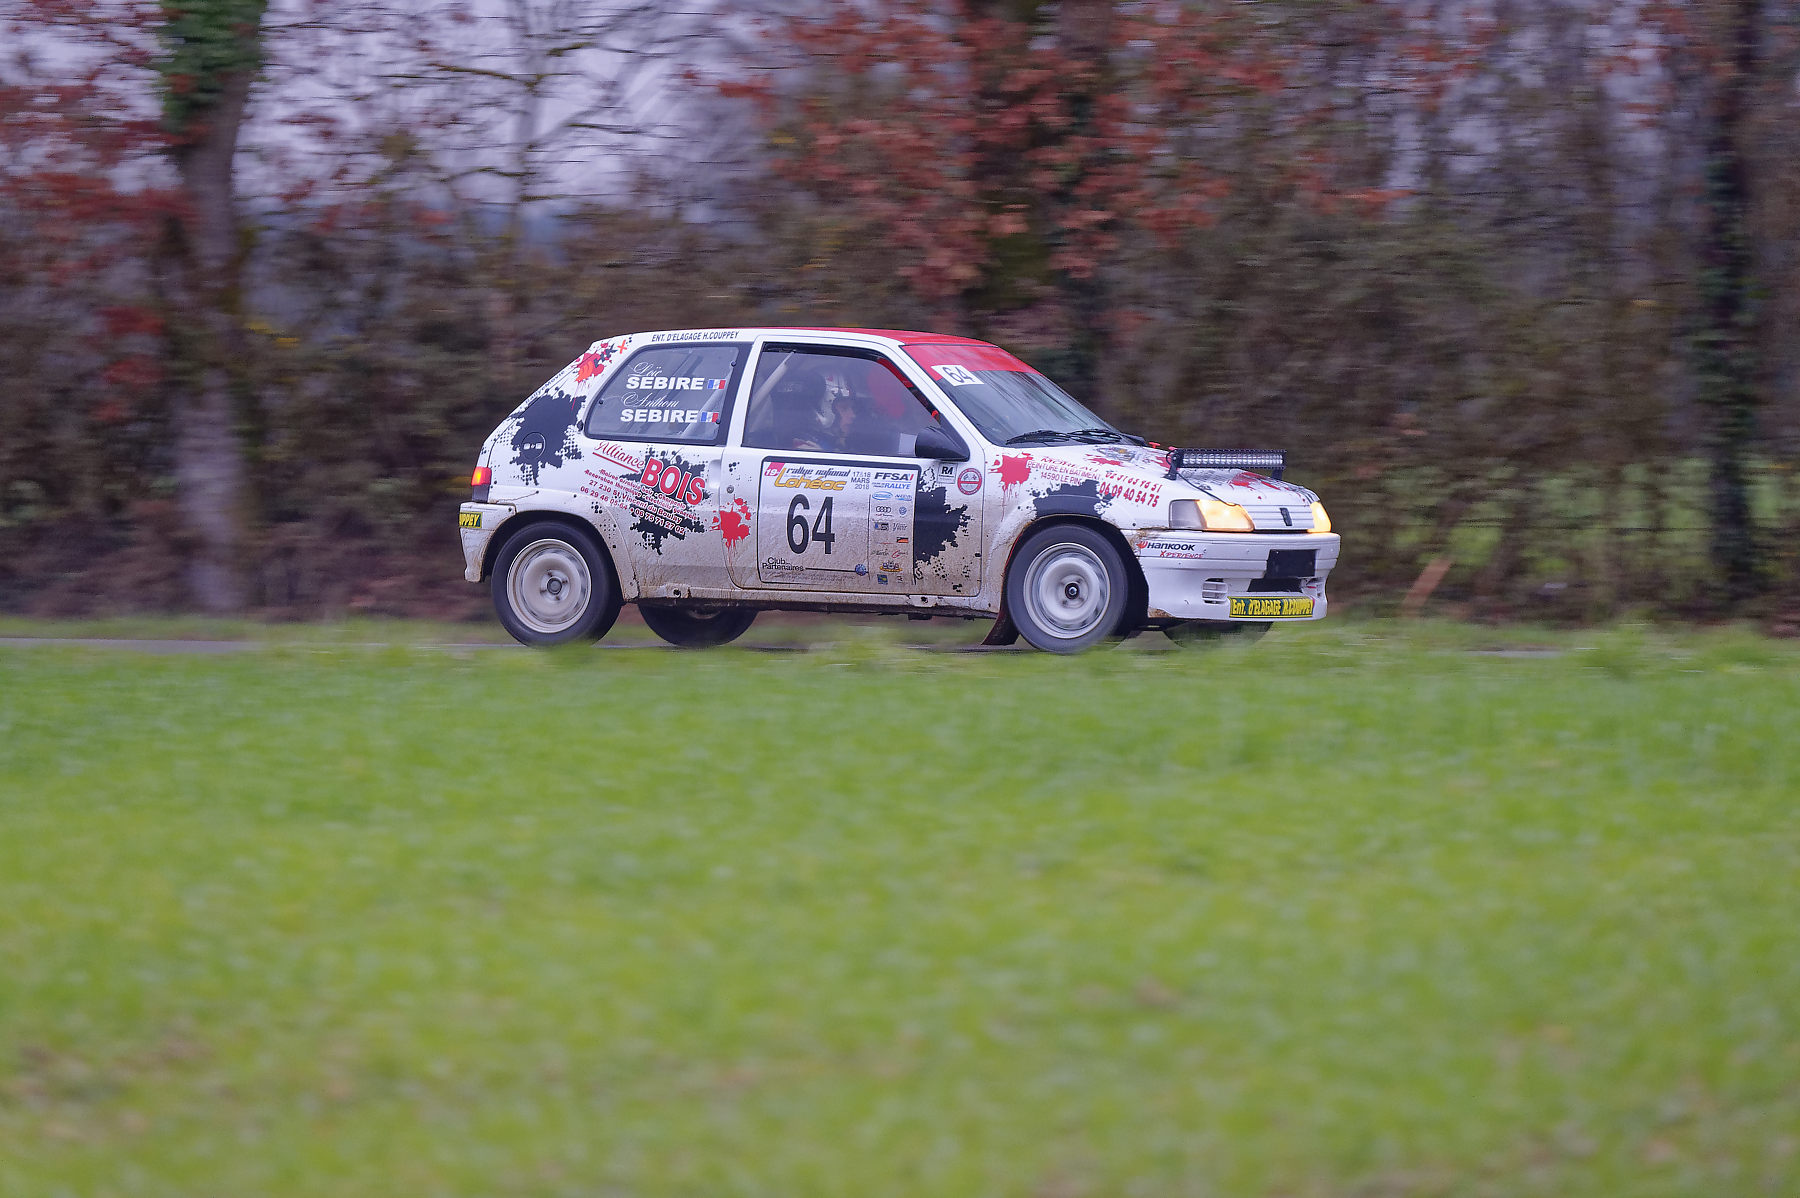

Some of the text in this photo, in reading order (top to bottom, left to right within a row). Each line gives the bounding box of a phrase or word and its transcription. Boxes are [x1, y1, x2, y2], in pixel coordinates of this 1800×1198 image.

[651, 334, 664, 342] ENT.
[942, 366, 976, 383] 64
[626, 376, 705, 390] SEBIRE
[620, 408, 699, 423] SEBIRE
[594, 440, 645, 469] Alliance
[786, 466, 814, 478] rallye
[874, 472, 910, 481] FFSA
[1041, 471, 1060, 481] 14590
[640, 457, 706, 506] BOIS
[885, 482, 911, 490] RALLYE
[599, 484, 611, 493] 230
[1099, 481, 1159, 507] 06 09 40 54 75
[786, 493, 836, 555] 64
[762, 563, 804, 571] Partenaires
[767, 557, 786, 565] Club
[1232, 598, 1246, 615] Ent.
